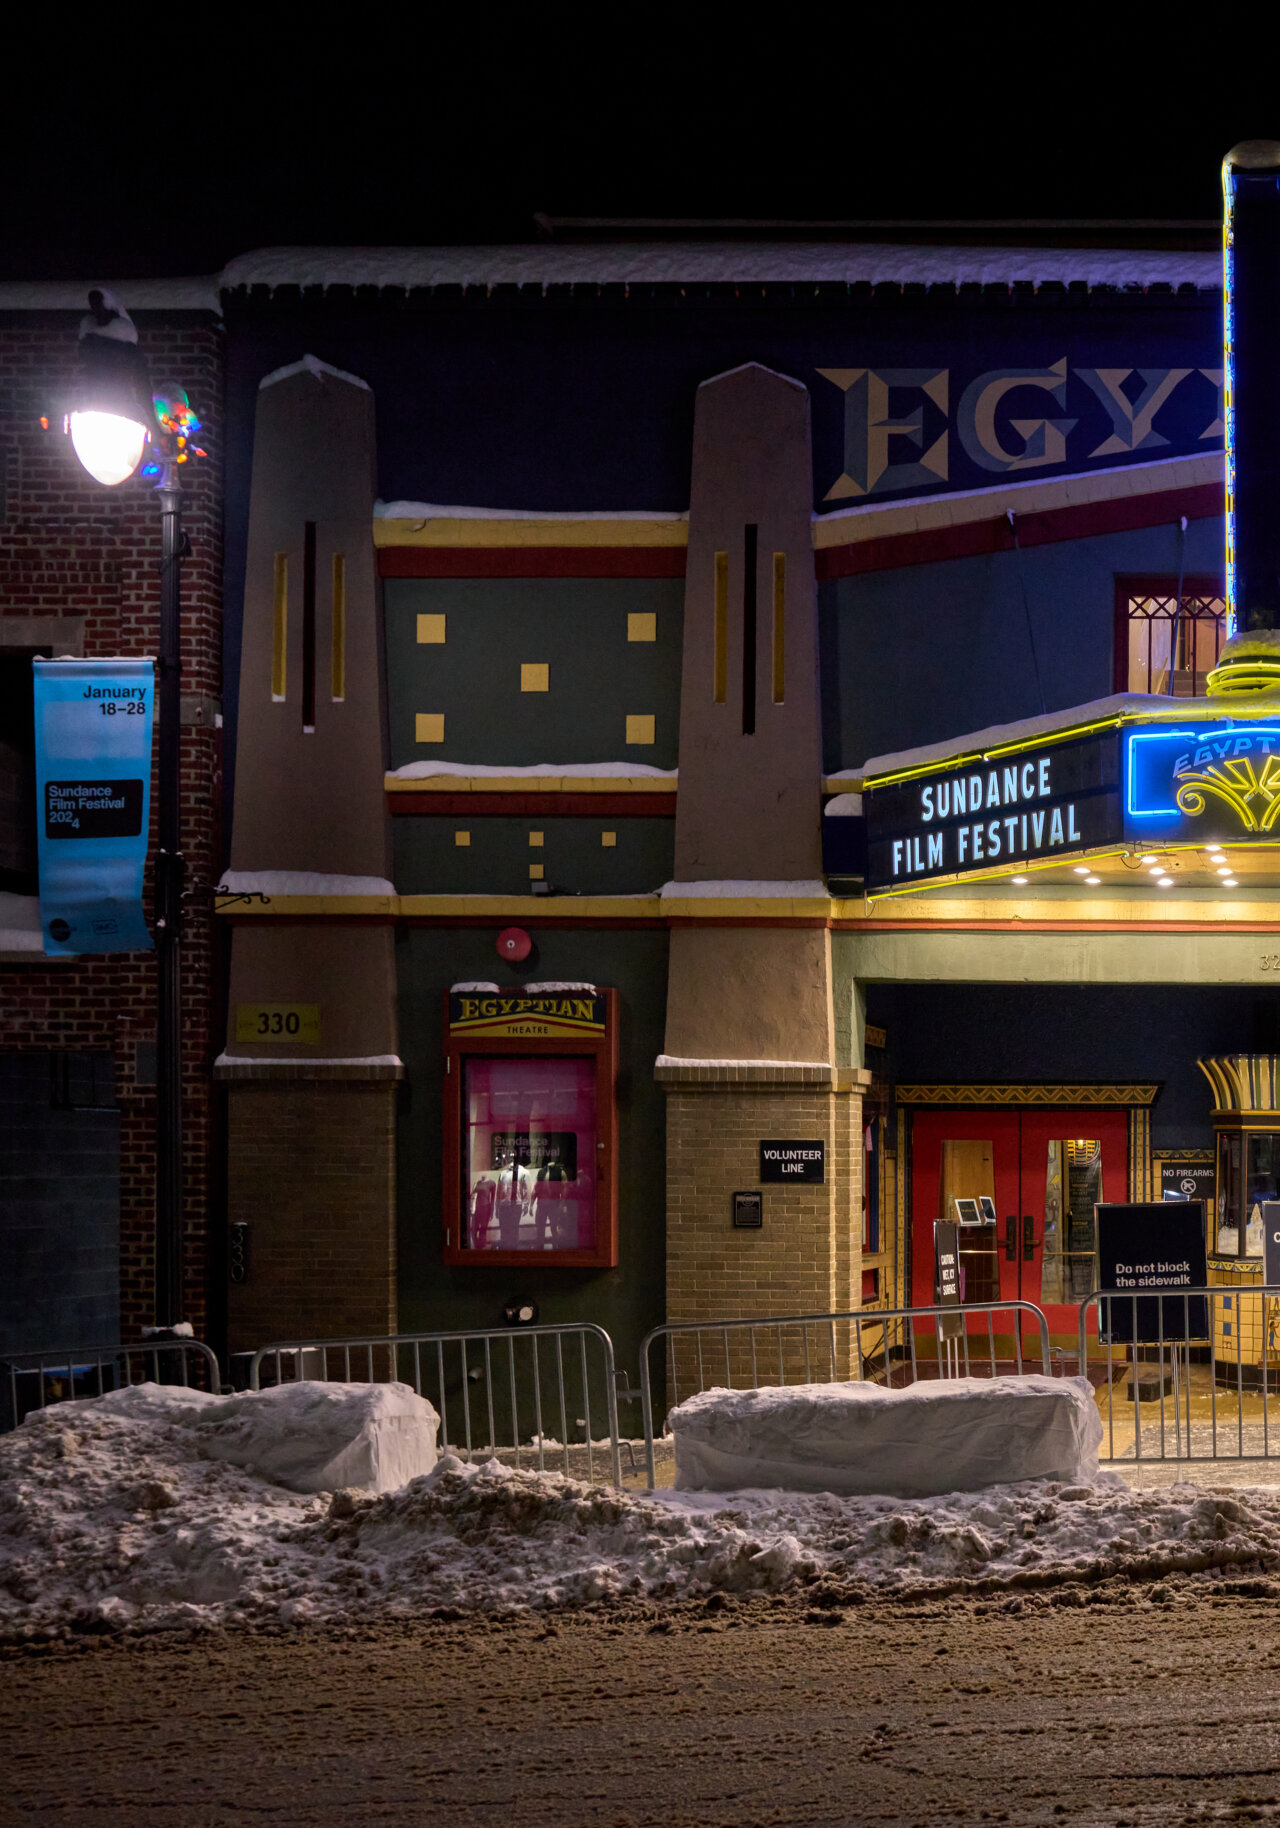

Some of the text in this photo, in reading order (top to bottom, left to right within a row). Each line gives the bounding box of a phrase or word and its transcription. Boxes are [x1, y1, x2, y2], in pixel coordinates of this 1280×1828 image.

[83, 685, 147, 701] January
[48, 785, 113, 798] Sundance
[921, 758, 1051, 822] SUNDANCE
[49, 797, 126, 811] Film Festival
[48, 811, 81, 830] 2024
[892, 804, 1081, 876] FILM FESTIVAL
[458, 998, 596, 1021] EGYPTIAN
[257, 1012, 300, 1034] 330
[507, 1026, 549, 1034] THEATRE
[494, 1136, 548, 1147] Sundance
[494, 1146, 561, 1157] Film Festival
[763, 1150, 822, 1160] VOLUNTEER
[781, 1163, 805, 1173] LINE
[1162, 1169, 1215, 1177] NO FIREARMS
[1115, 1260, 1191, 1274] Do not block
[1116, 1273, 1192, 1287] the sidewalk
